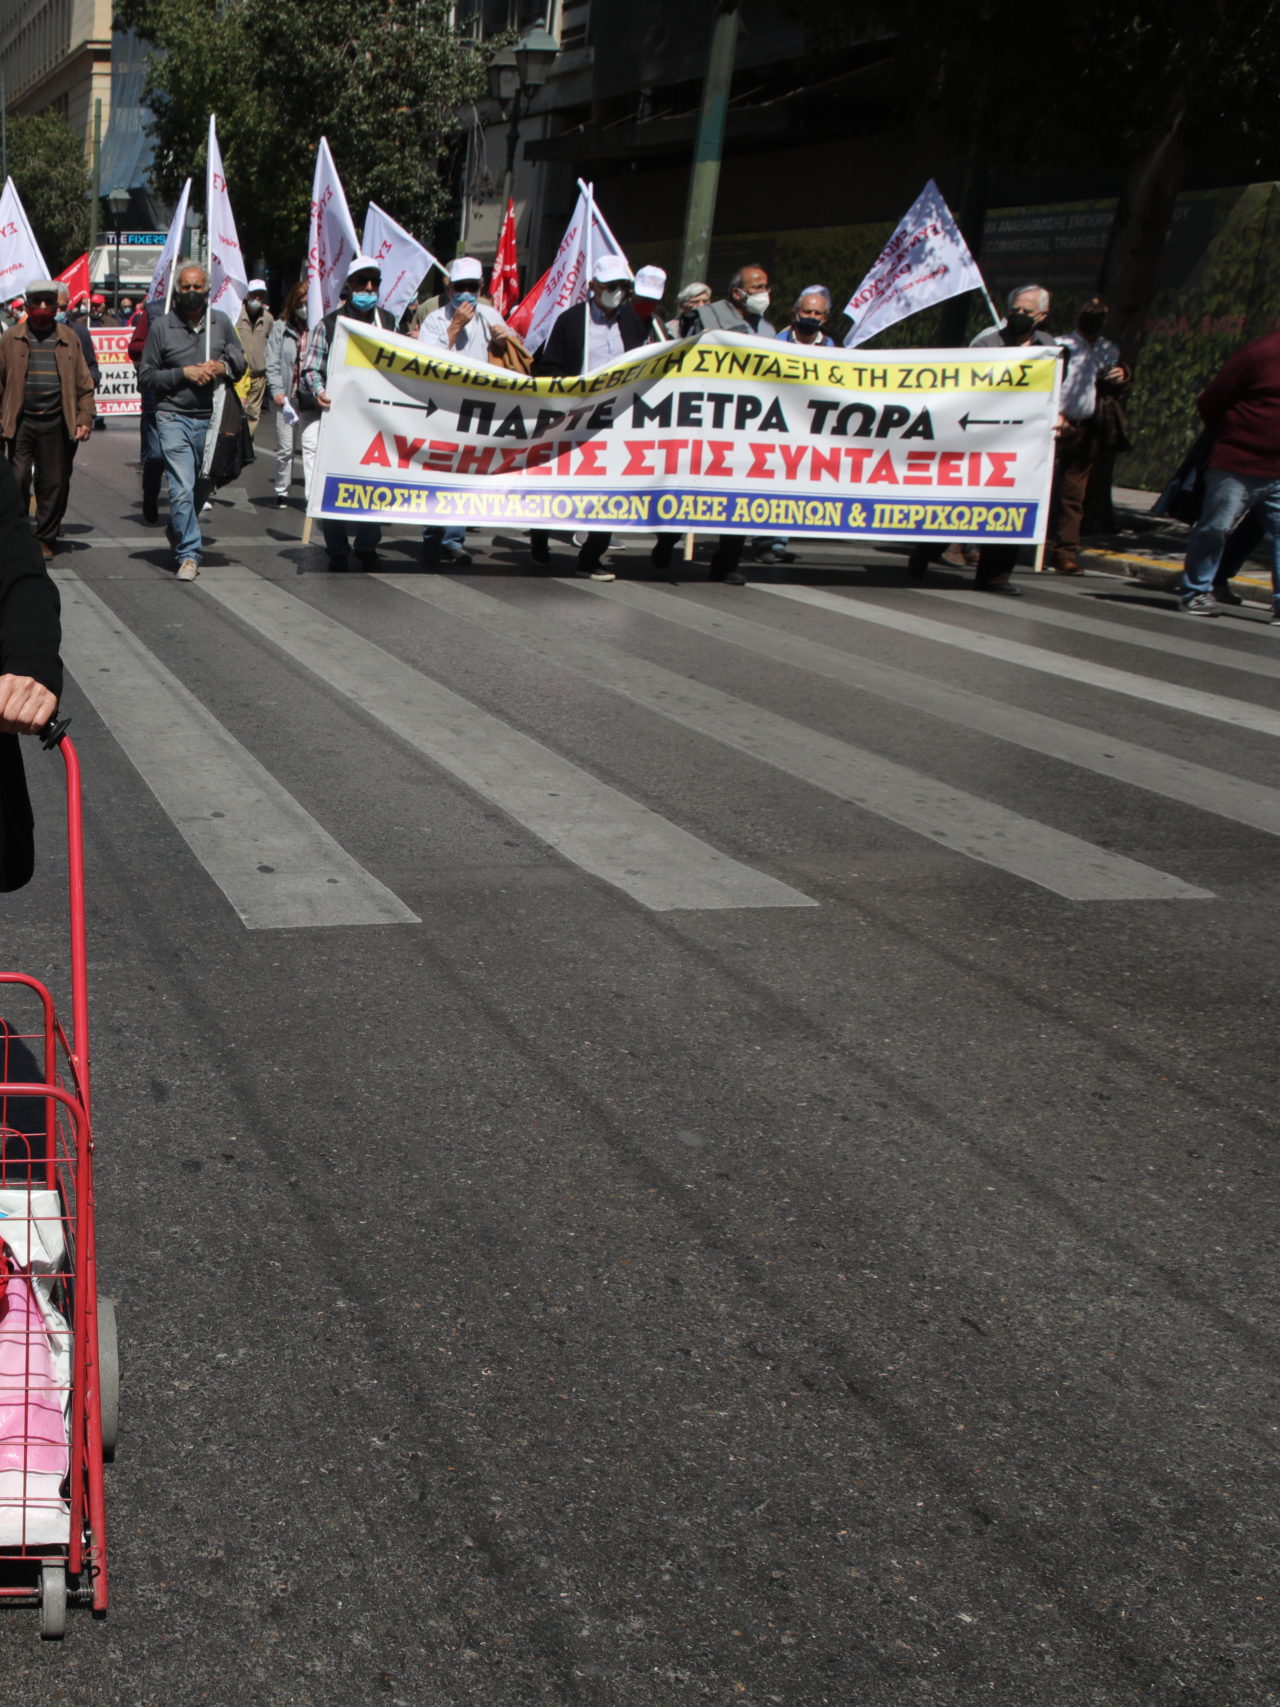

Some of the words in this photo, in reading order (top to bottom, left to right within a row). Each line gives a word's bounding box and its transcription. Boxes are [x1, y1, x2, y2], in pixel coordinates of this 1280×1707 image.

[128, 234, 167, 244] FIXERS
[374, 347, 397, 368] Η
[650, 350, 686, 374] ΤΗ
[692, 350, 819, 380] ΣΥΝΤΑΞΗ
[828, 365, 845, 386] &
[853, 367, 887, 388] ΤΗ
[897, 367, 959, 389] ΖΩΗ
[970, 364, 1033, 387] ΜΑΣ
[456, 396, 618, 440] ΠΑΡΤΕ
[631, 391, 789, 433] ΜΕΤΡΑ
[806, 399, 935, 440] ΤΩΡΑ
[359, 430, 608, 476] ΑΥΞΗΣΕΙΣ
[621, 439, 735, 477] ΣΤΙΣ
[745, 442, 1018, 488] ΣΥΝΤΑΞΕΙΣ
[335, 483, 428, 513] ΕΝΩΣΗ
[434, 491, 651, 520] ΣΥΝΤΑΞΙΟΥΧΩΝ
[657, 495, 728, 520] ΟΑΕΕ
[732, 498, 843, 527] ΑΘΗΝΩΝ
[848, 503, 866, 527] &
[872, 503, 1027, 532] ΠΕΡΙΧΩΡΩΝ
